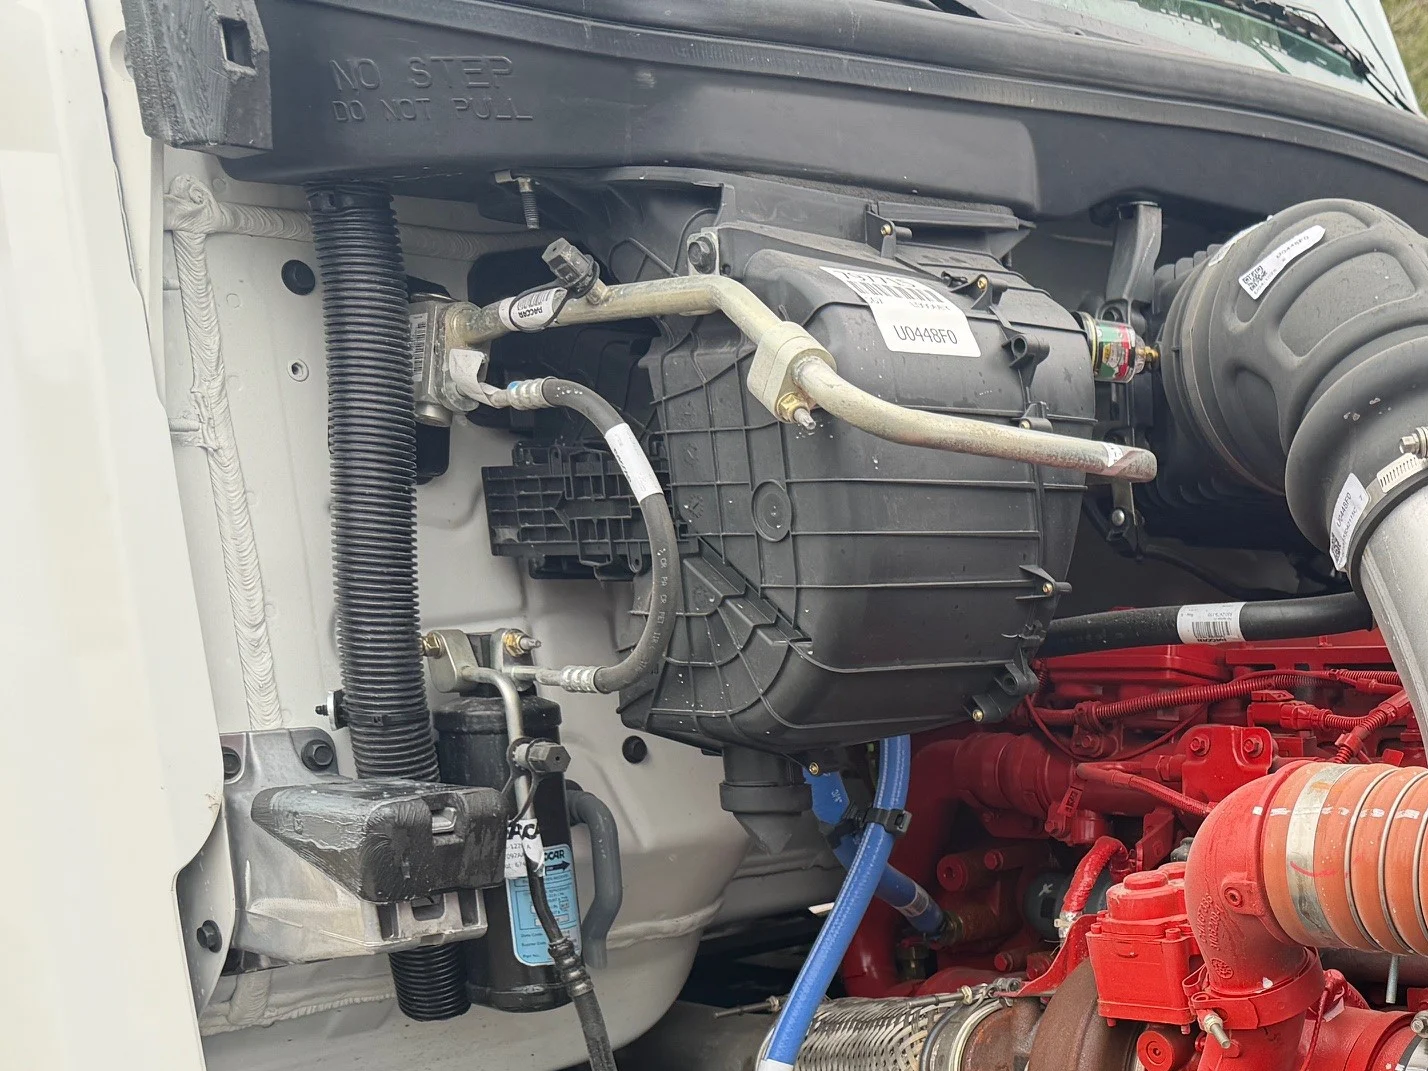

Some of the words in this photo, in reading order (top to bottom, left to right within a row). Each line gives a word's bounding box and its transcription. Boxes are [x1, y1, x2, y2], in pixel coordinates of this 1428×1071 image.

[329, 57, 382, 92] NO
[408, 56, 513, 88] STEP
[333, 100, 366, 121] DO
[381, 98, 431, 121] NOT
[450, 97, 534, 120] PULL
[893, 325, 957, 345] U0448F0
